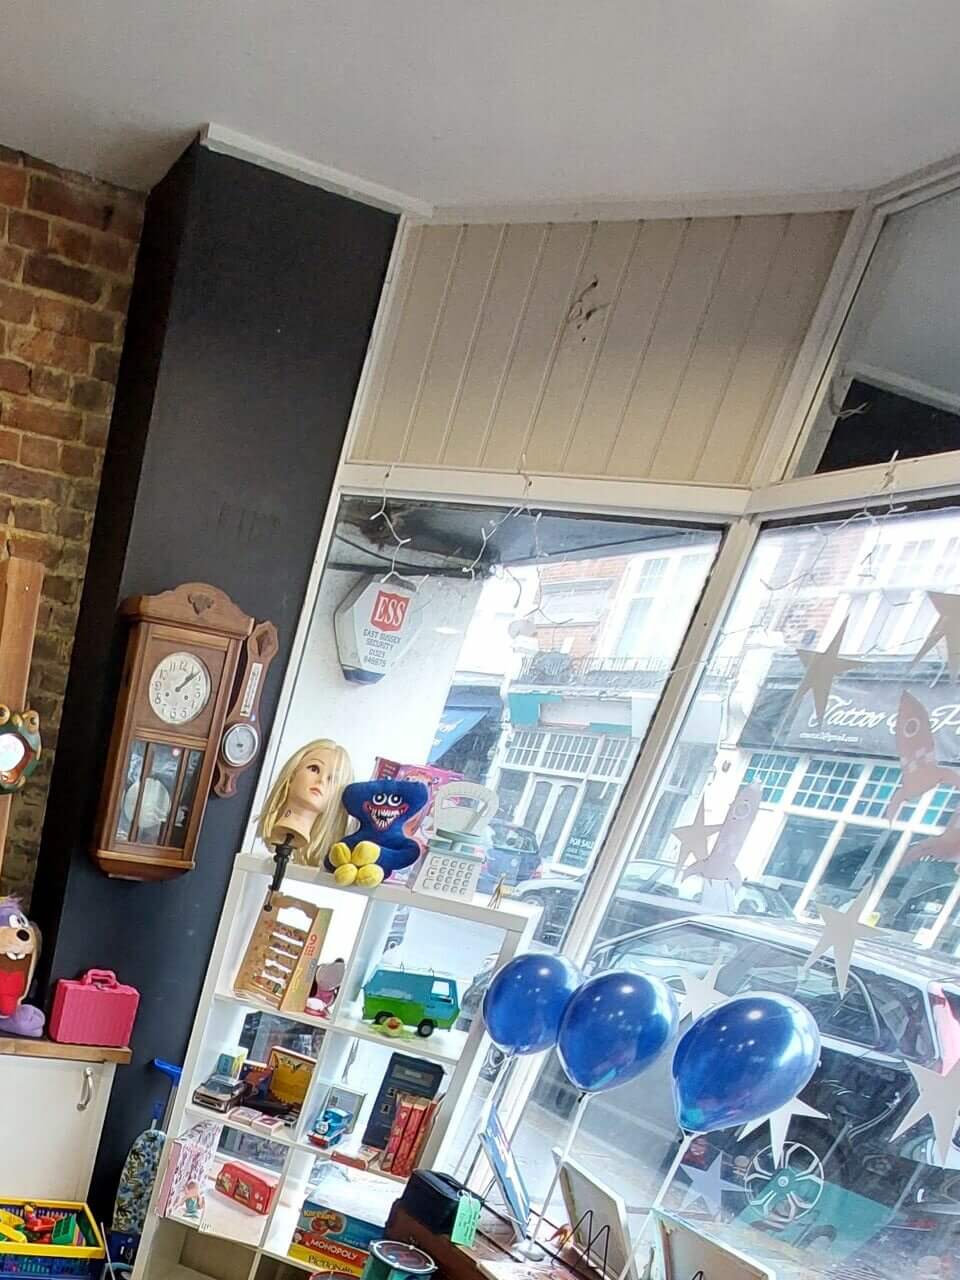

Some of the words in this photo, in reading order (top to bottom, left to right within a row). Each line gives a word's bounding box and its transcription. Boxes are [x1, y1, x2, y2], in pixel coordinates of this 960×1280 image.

[373, 596, 406, 626] ESS
[363, 628, 379, 638] EAST
[366, 638, 394, 650] SECURITY
[808, 694, 886, 729] Tattoo
[311, 1239, 359, 1260] MONOPOLY
